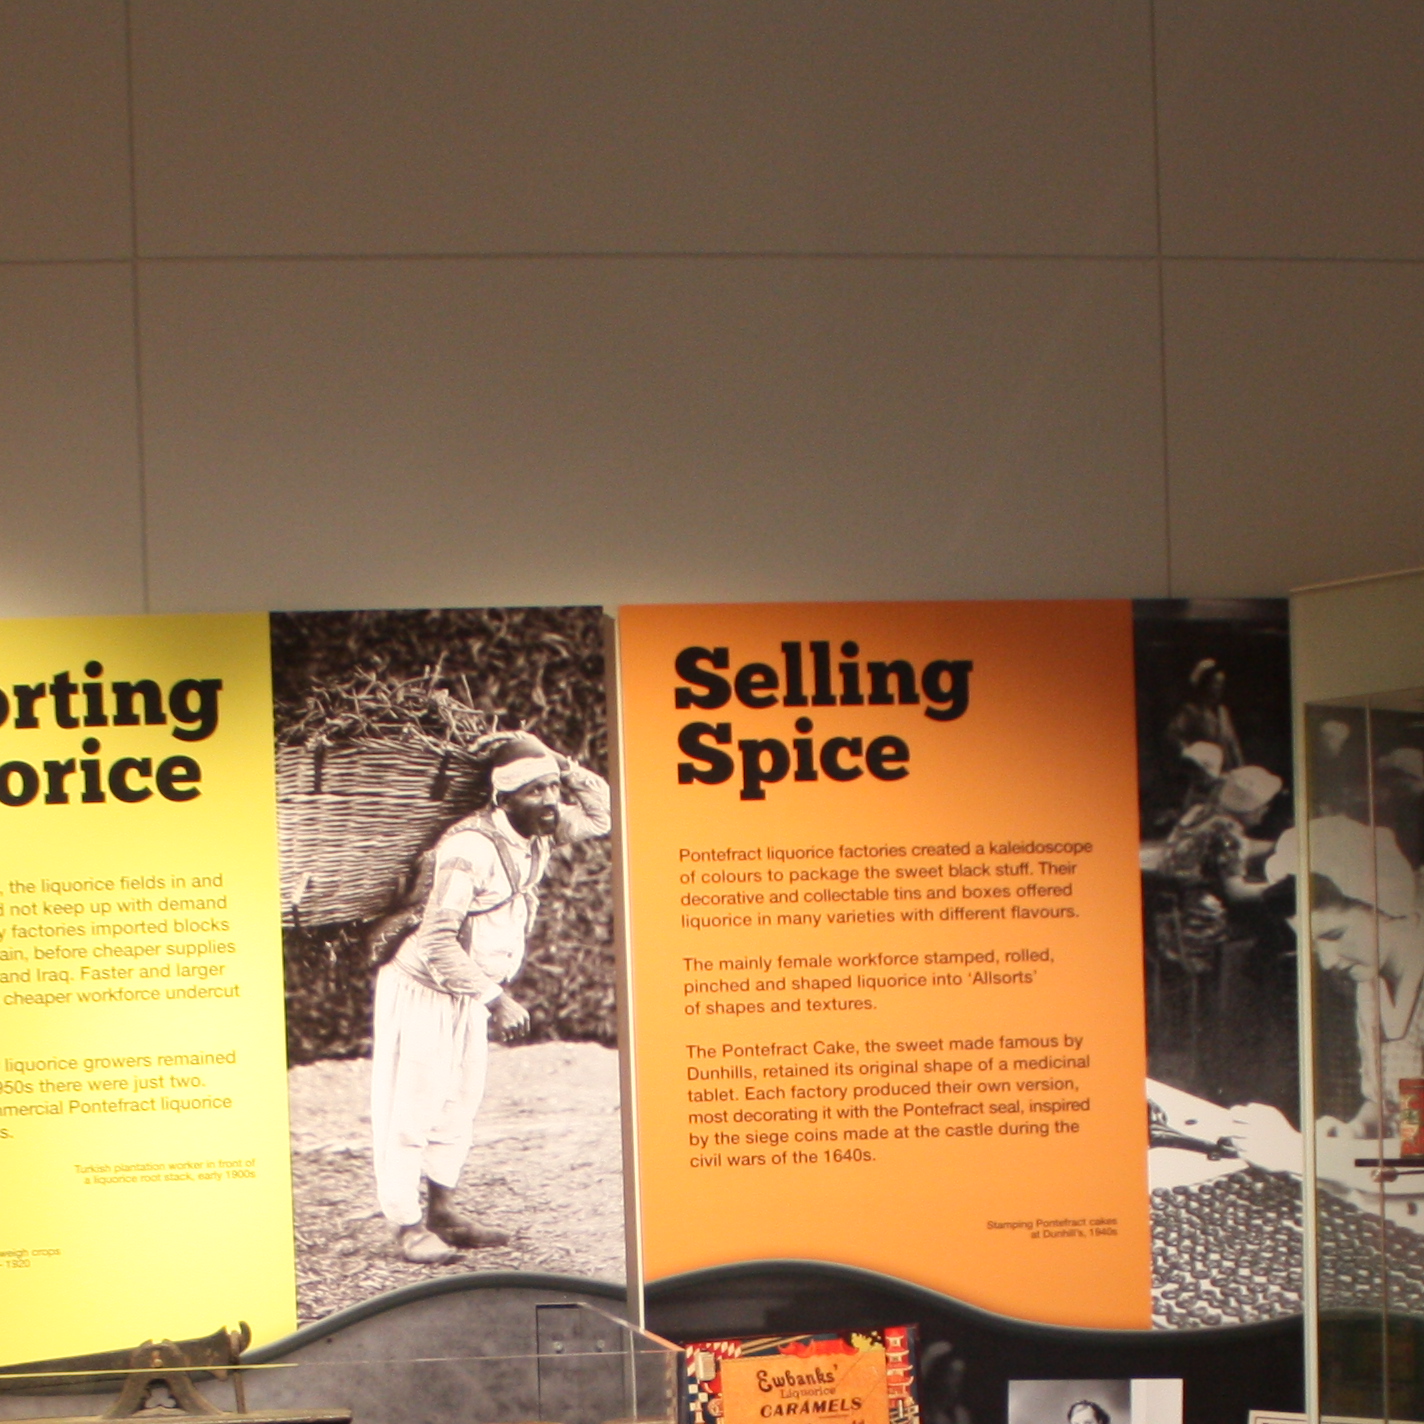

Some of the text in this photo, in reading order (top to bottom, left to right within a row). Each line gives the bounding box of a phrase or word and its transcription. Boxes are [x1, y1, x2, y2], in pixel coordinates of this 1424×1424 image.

[674, 640, 973, 722] Selling
[677, 717, 910, 800] Spice
[679, 840, 1093, 862] Pontefract liquorice factories created a kaleidoscope
[8, 879, 35, 894] the
[41, 879, 114, 894] liquorice
[119, 875, 165, 889] fields
[171, 877, 185, 888] in
[191, 872, 222, 888] and
[682, 948, 1054, 972] The mainly female workforce stamped, rolled,
[38, 1079, 82, 1092] there
[87, 1079, 128, 1090] were
[134, 1075, 164, 1092] just
[169, 1075, 204, 1087] two.
[986, 1217, 1117, 1230] Stamping Pontefract cakes
[780, 1386, 836, 1399] Liquorice
[760, 1398, 862, 1419] CARAMELS
